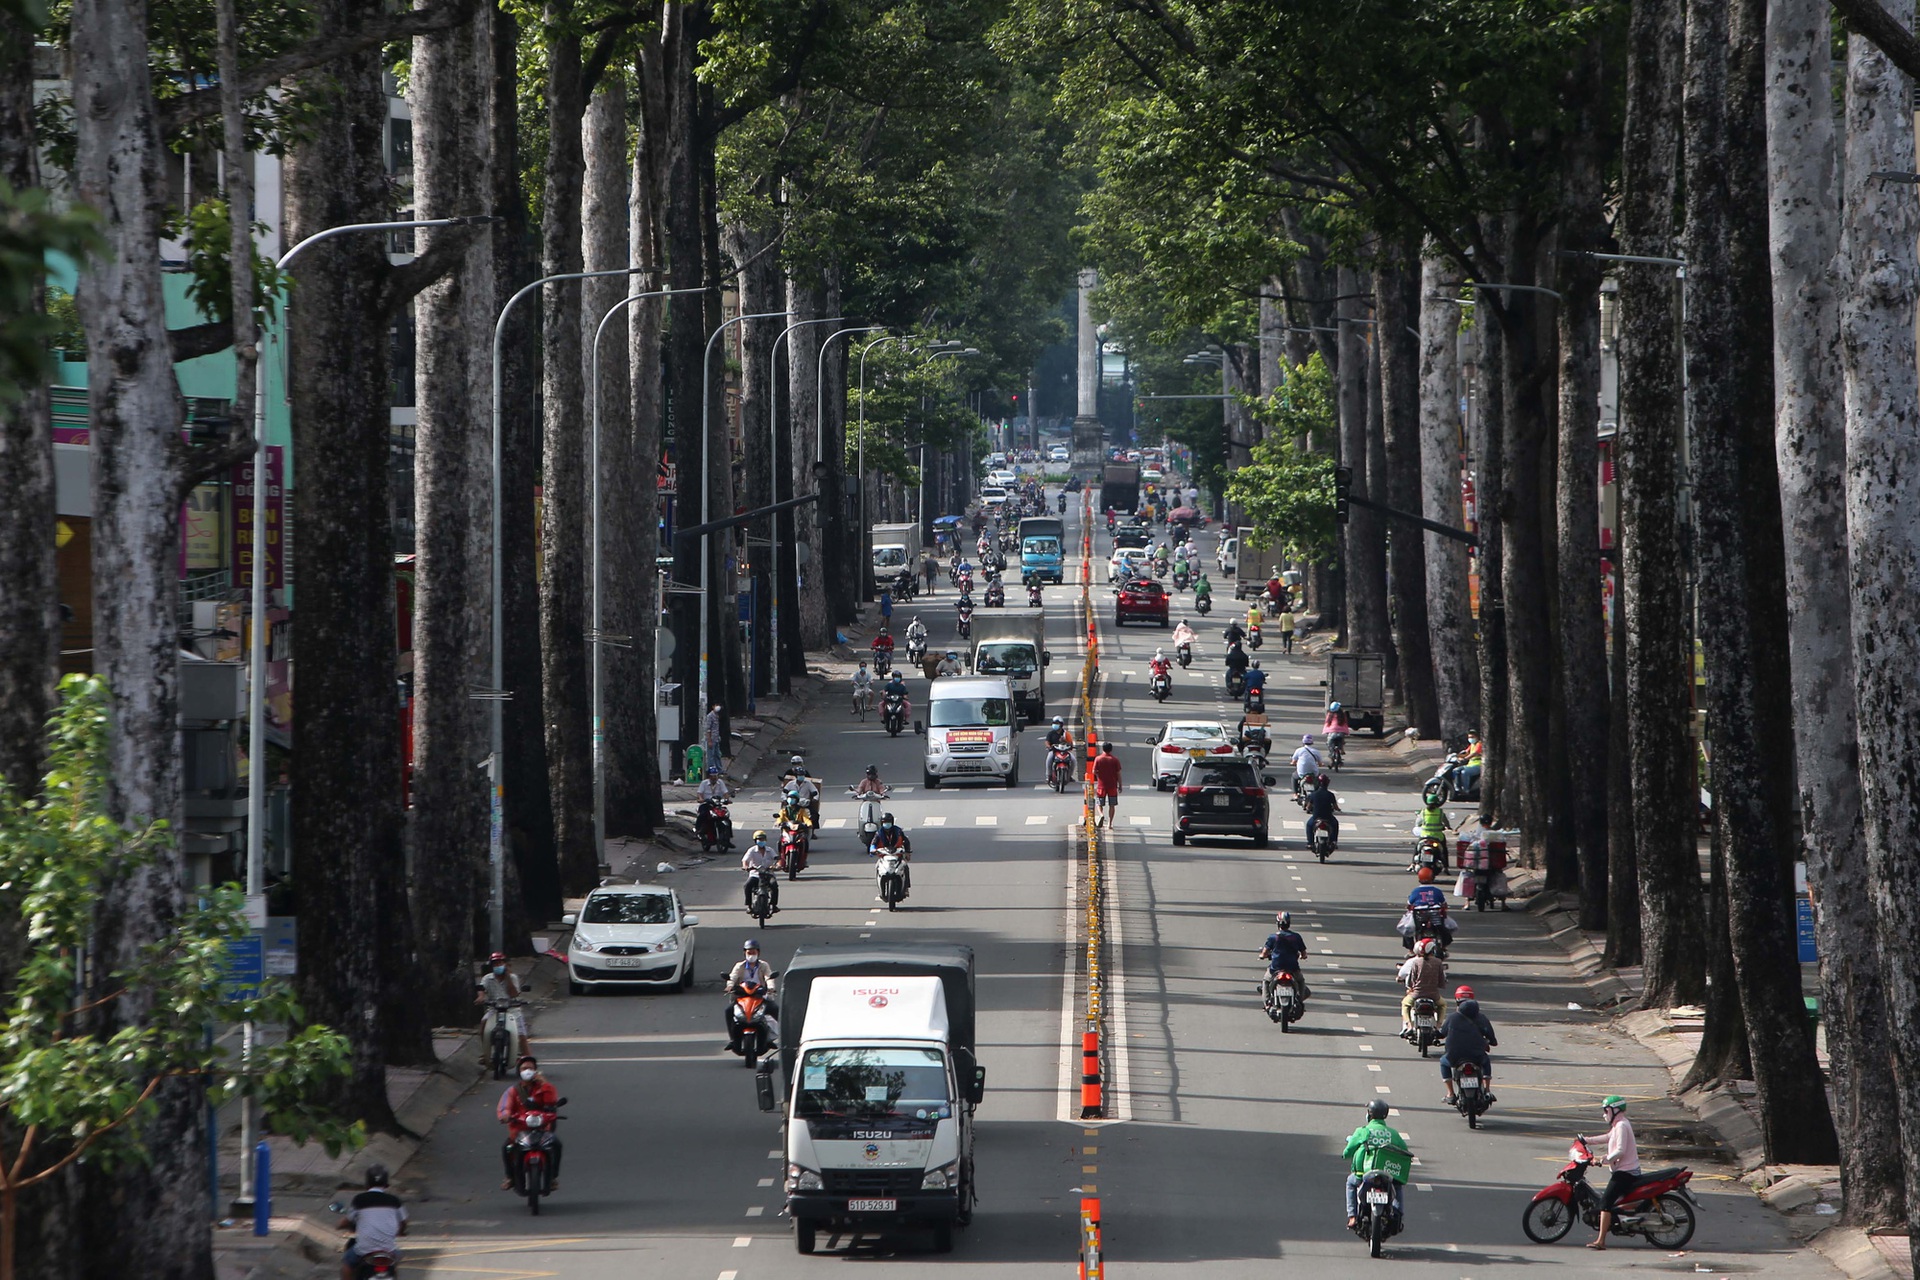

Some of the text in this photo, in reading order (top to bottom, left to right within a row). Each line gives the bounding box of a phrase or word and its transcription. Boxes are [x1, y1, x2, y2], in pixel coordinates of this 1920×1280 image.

[238, 508, 277, 523] BN
[853, 988, 899, 996] ISUZU
[853, 1130, 892, 1139] ISUZU
[1385, 1160, 1402, 1170] Grab
